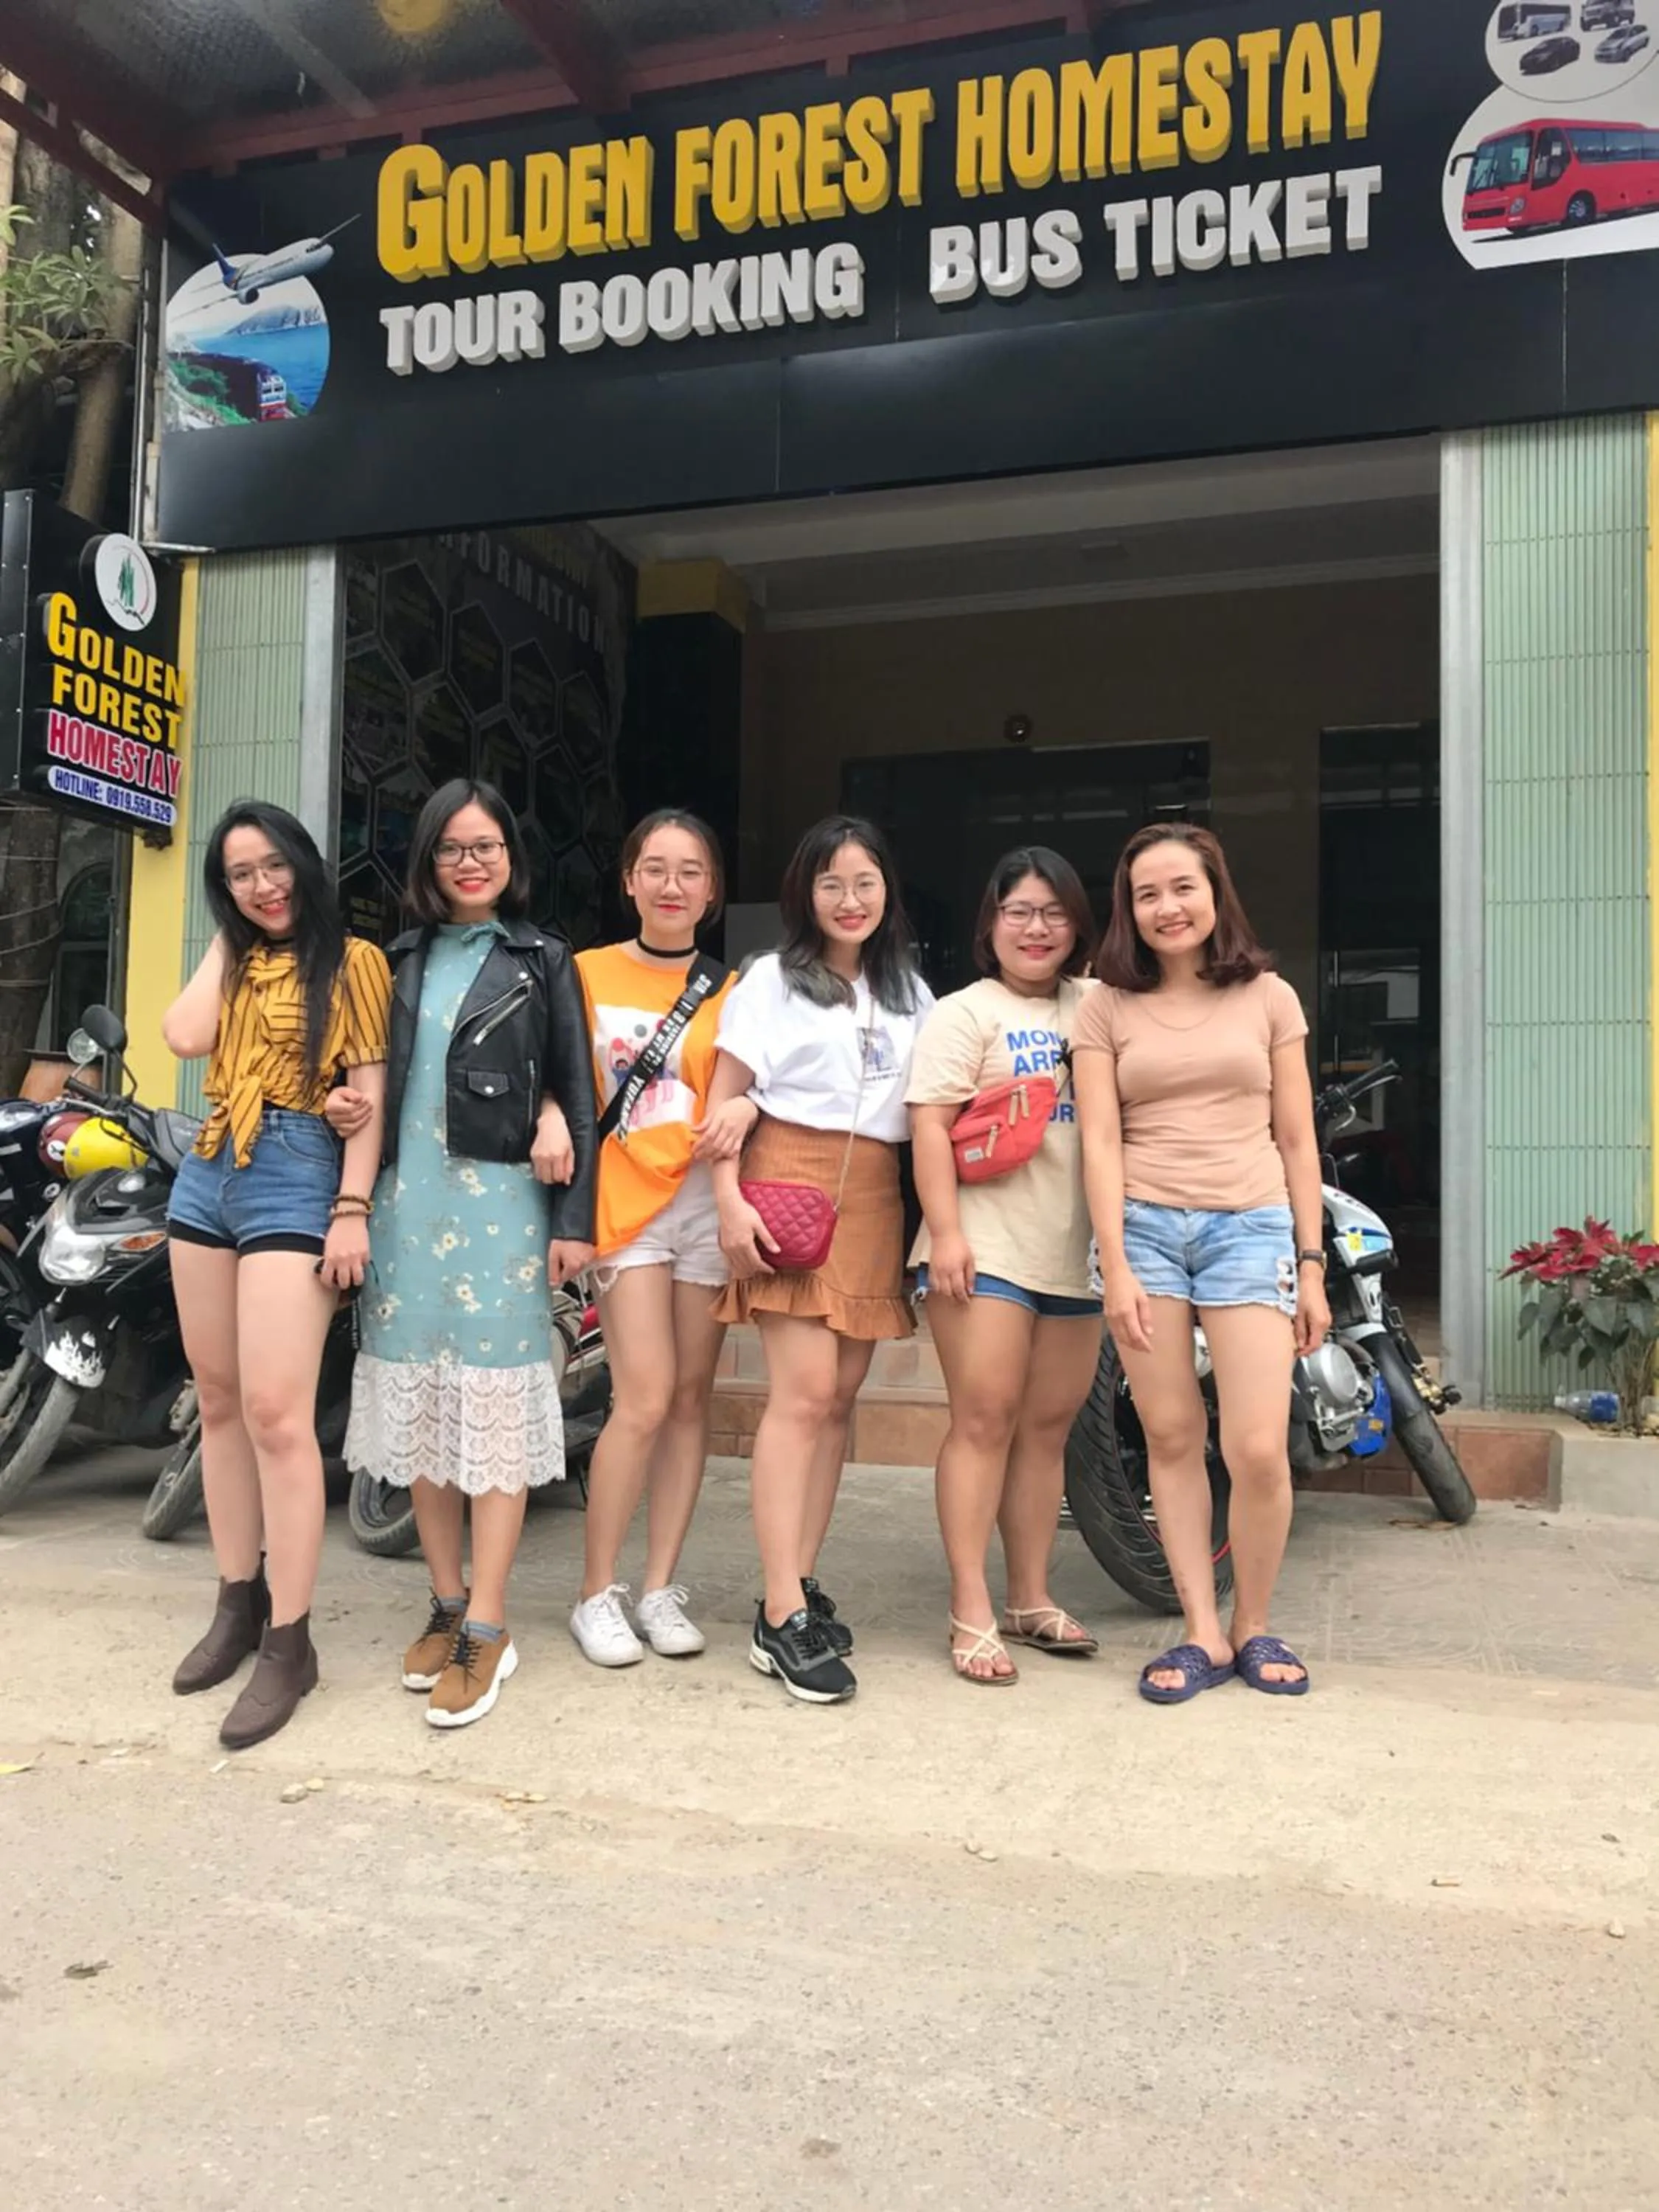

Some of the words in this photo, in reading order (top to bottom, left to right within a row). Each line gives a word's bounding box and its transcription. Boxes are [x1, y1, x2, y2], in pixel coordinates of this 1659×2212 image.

[377, 138, 654, 282] GOLDEN
[675, 88, 935, 241] FOREST
[956, 10, 1382, 198] HOMESTAY
[380, 289, 546, 375] TOUR
[559, 242, 866, 355] BOOKING
[929, 209, 1083, 305] BUS
[1104, 165, 1382, 282] TICKET
[47, 591, 187, 709] GOLDEN
[439, 530, 605, 655] FORMATION
[47, 709, 183, 799] HOMESTAY
[52, 663, 183, 750] FOREST
[55, 768, 102, 801] HOTLINE:
